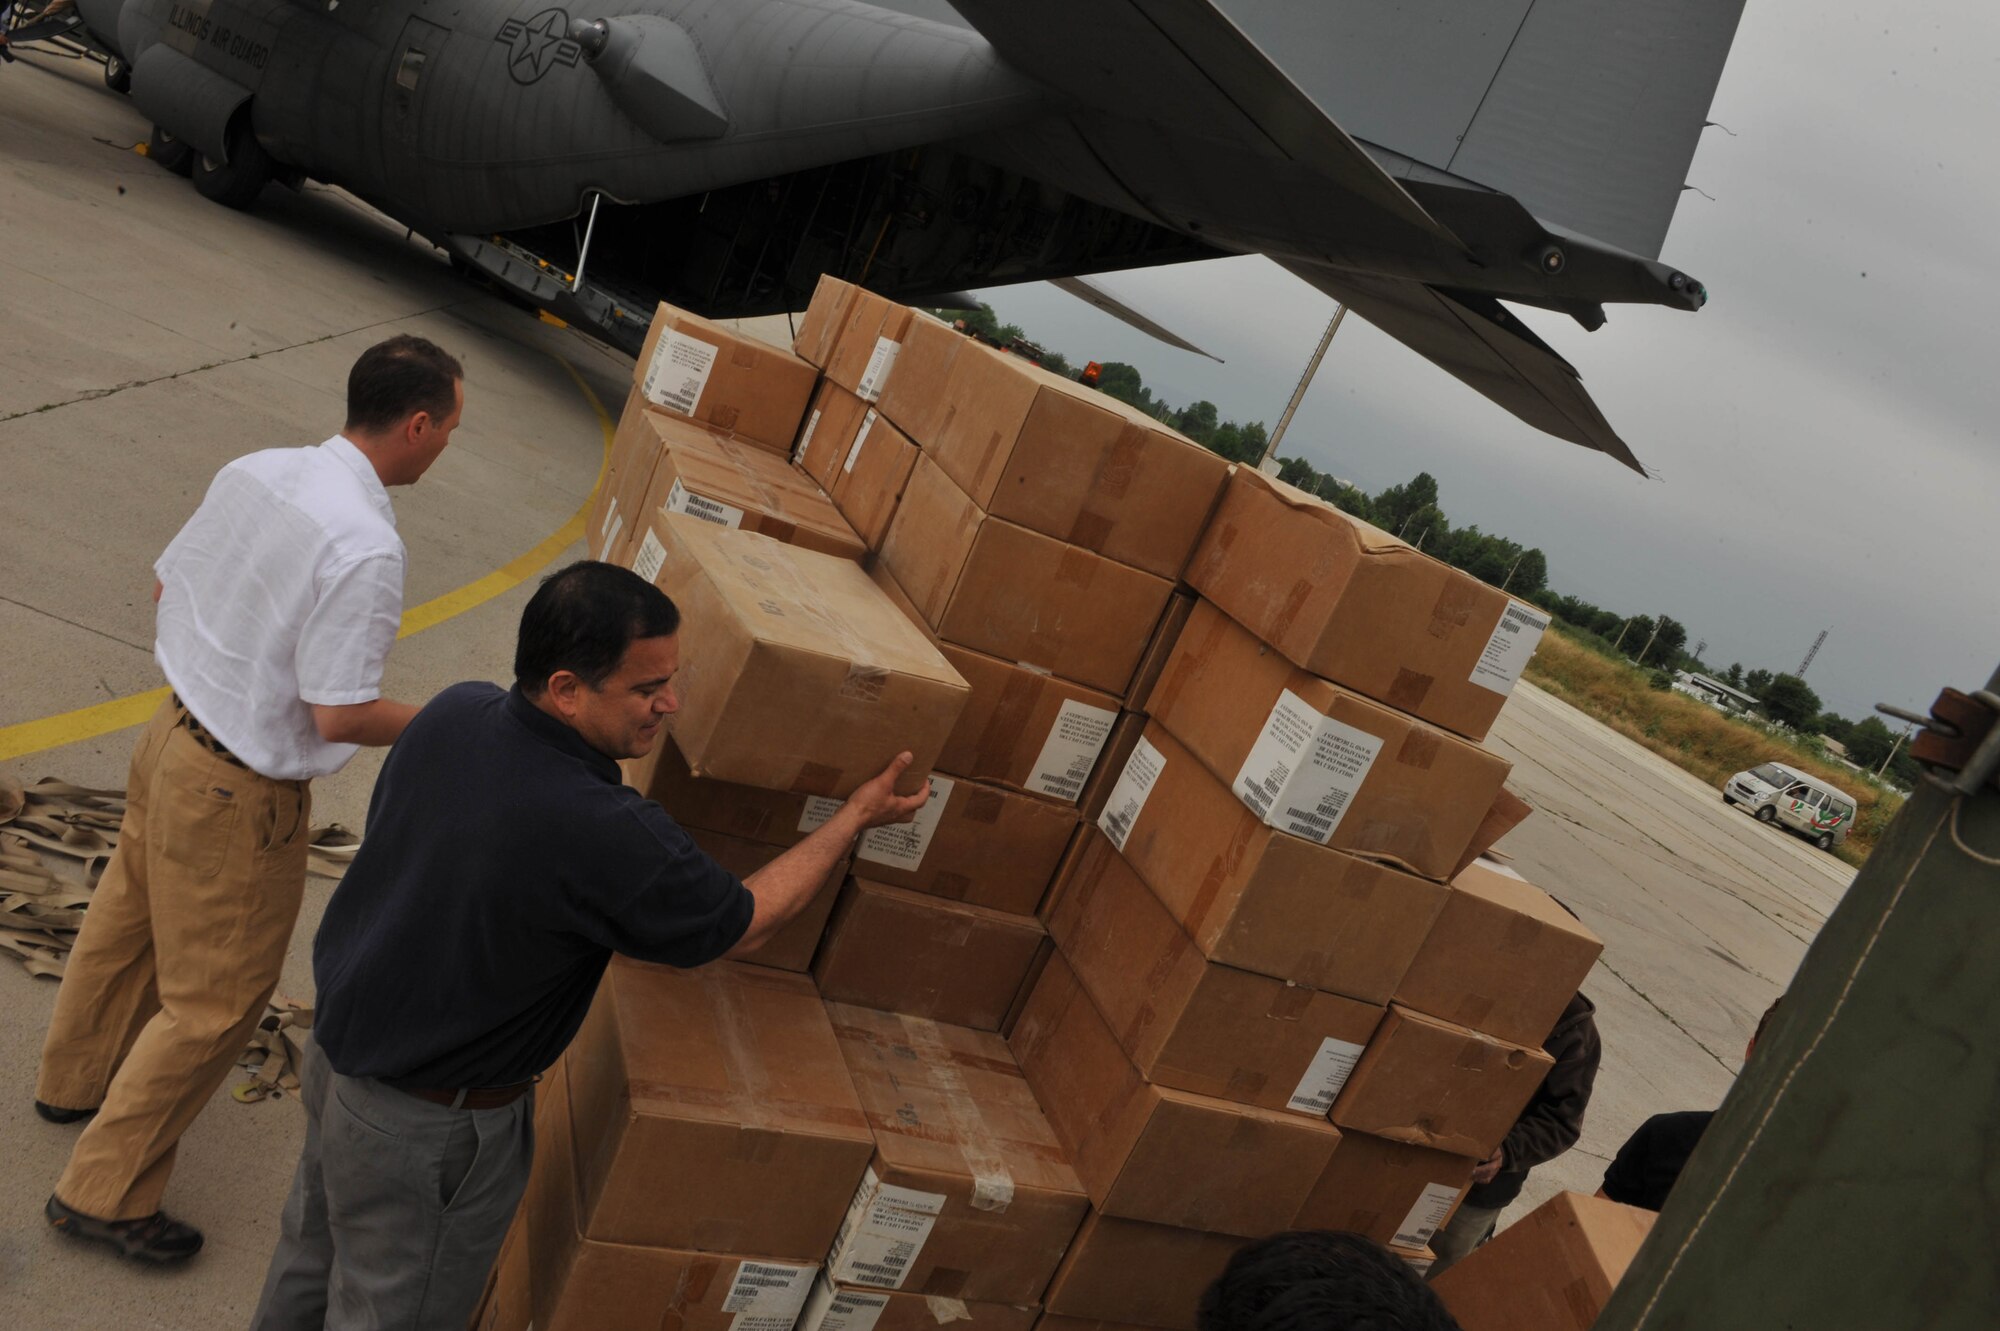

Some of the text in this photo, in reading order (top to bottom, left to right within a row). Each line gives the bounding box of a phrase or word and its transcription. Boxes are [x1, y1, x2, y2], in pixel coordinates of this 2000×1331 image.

[169, 4, 269, 69] ILLINOIS AIR GUARD
[1327, 734, 1349, 745] DEGREES
[1316, 737, 1370, 762] MAINTAINED BETWEEN
[1340, 754, 1362, 766] PRODUCT
[1339, 769, 1354, 778] SHELF
